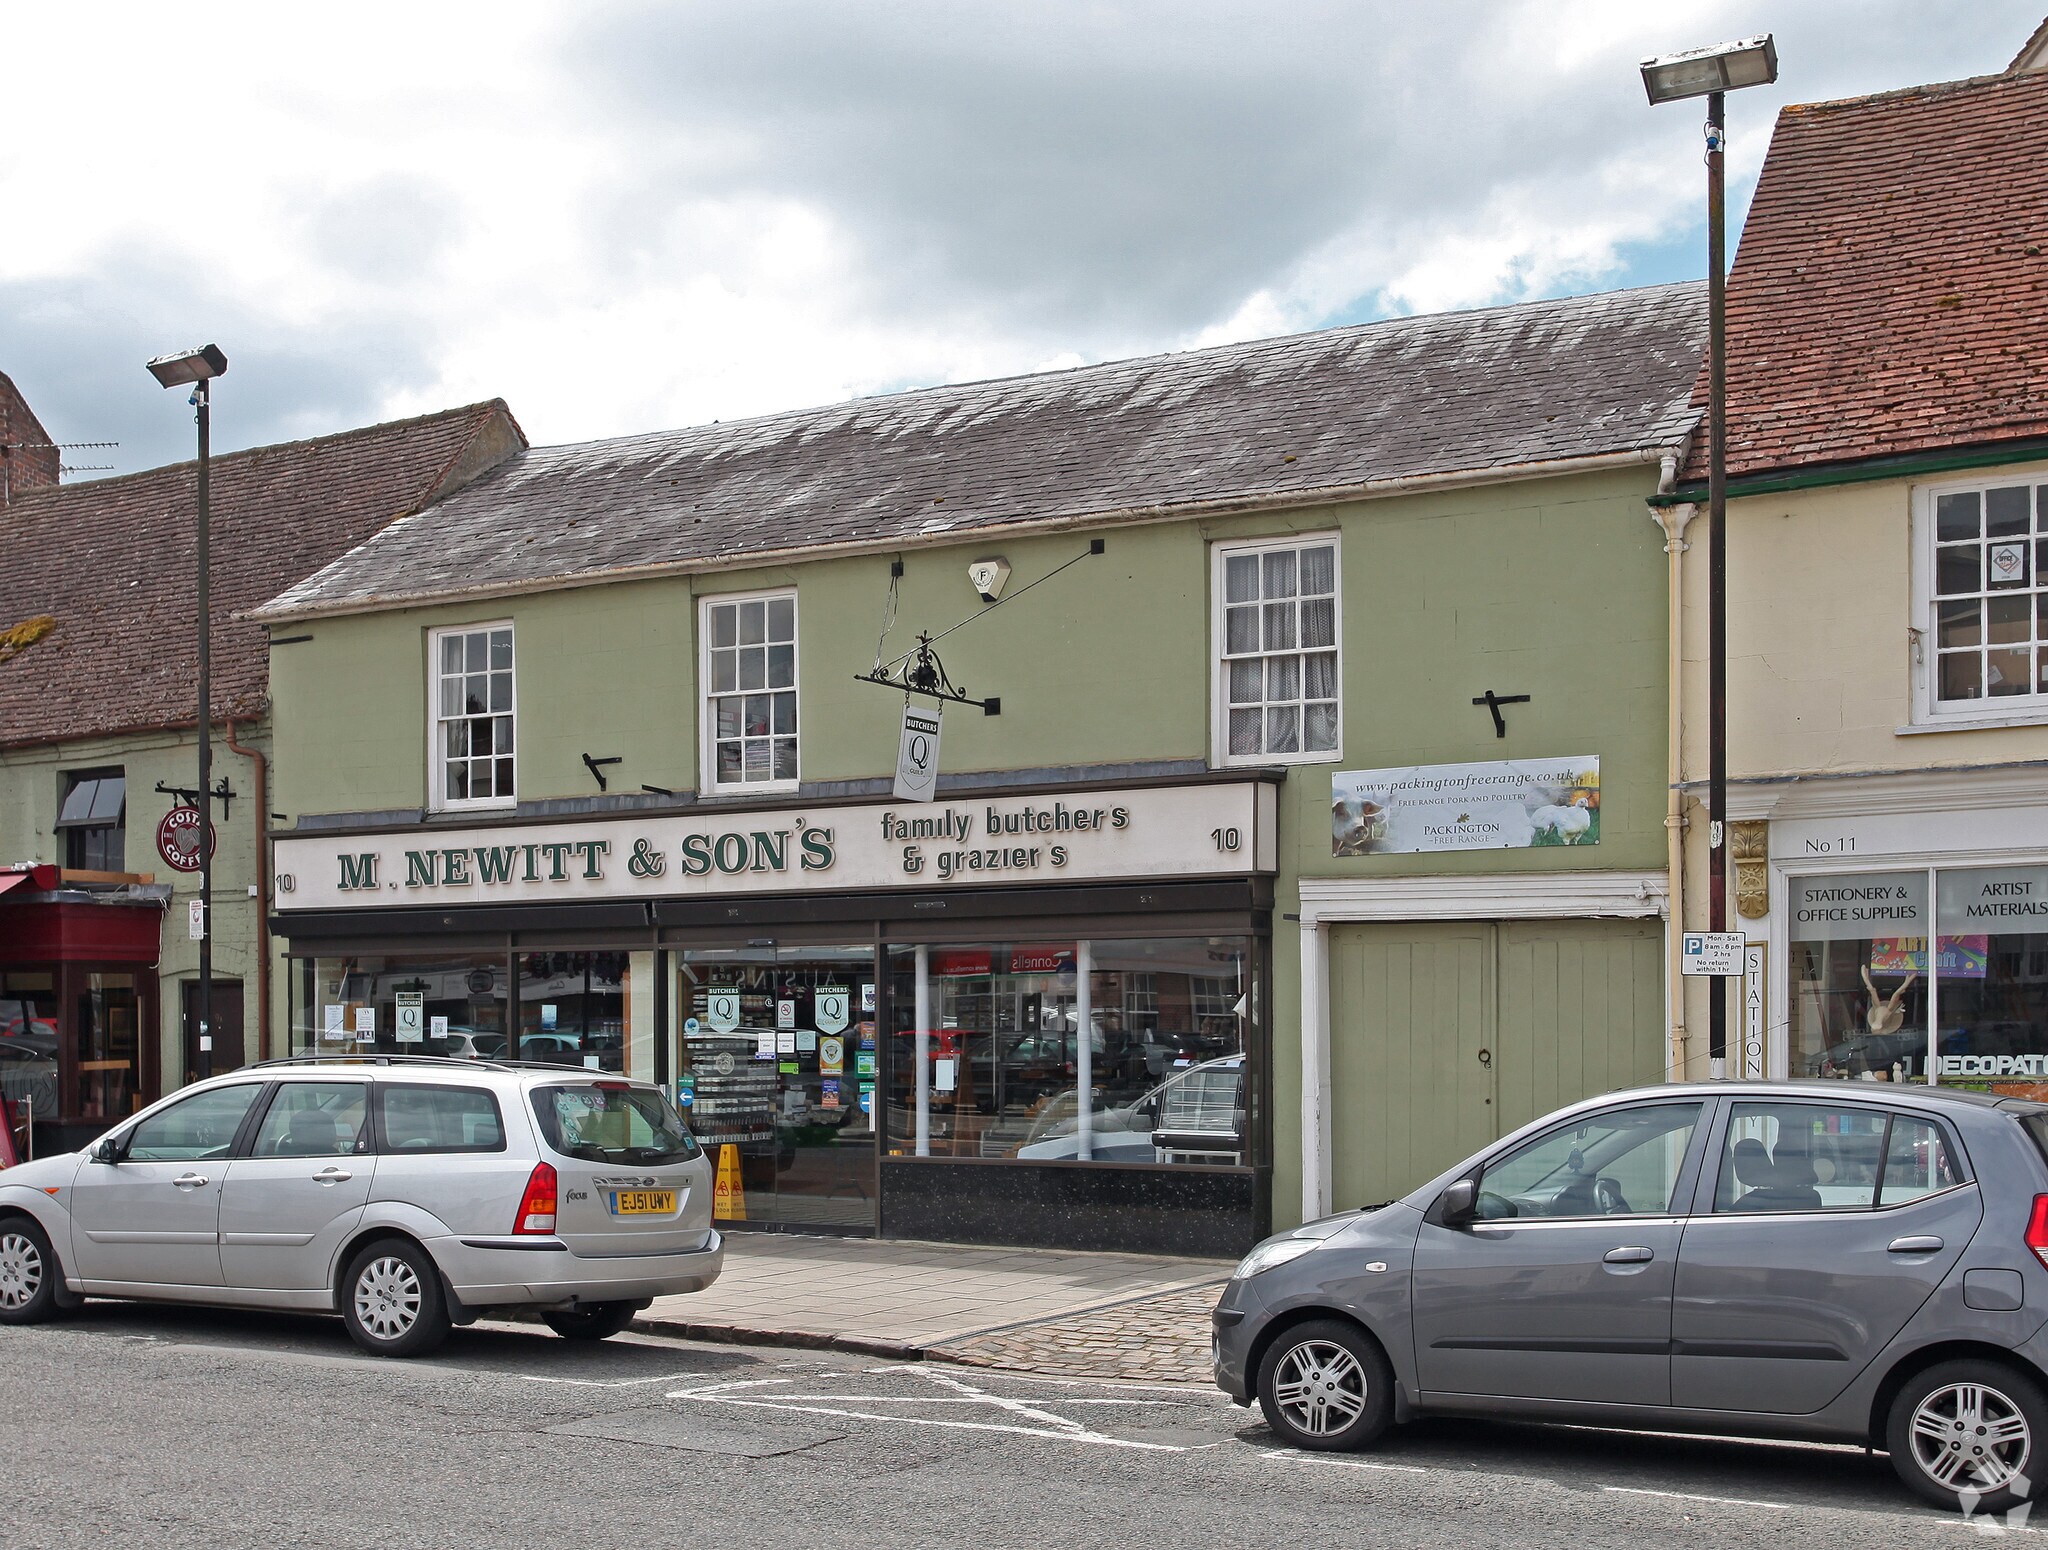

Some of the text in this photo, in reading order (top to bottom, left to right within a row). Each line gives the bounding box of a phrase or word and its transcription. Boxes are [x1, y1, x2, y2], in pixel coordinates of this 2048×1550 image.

[906, 718, 938, 733] BUTCHERS
[911, 735, 928, 769] Q
[1355, 768, 1574, 794] www.packingtonfreerange.co.uk
[1418, 798, 1444, 806] RANGE
[1447, 796, 1469, 804] PORK
[1471, 795, 1489, 803] AND
[1491, 792, 1528, 802] POULTRY
[881, 809, 972, 843] family
[1424, 822, 1500, 836] PACKINGTON
[1210, 826, 1242, 853] 10
[1434, 834, 1489, 845] FREE RANGE
[1805, 837, 1857, 853] No 11
[404, 839, 611, 887] NEWITT
[627, 837, 666, 879] &
[681, 817, 835, 876] SON'S
[902, 844, 925, 875] &
[275, 873, 296, 893] 10
[1981, 882, 2033, 896] ARTIST
[1805, 886, 1908, 903] STATIONERY &
[1797, 905, 1917, 922] OFFICE SUPPLIES
[1966, 901, 2048, 917] MATERIALS
[1688, 939, 1700, 954] P
[1896, 936, 1928, 952] ART
[816, 986, 848, 994] BUTCHERS
[716, 997, 733, 1020] Q
[823, 996, 842, 1020] Q
[403, 1008, 417, 1027] Q
[566, 1188, 588, 1204] focus
[621, 1192, 671, 1211] EJ51 UWY
